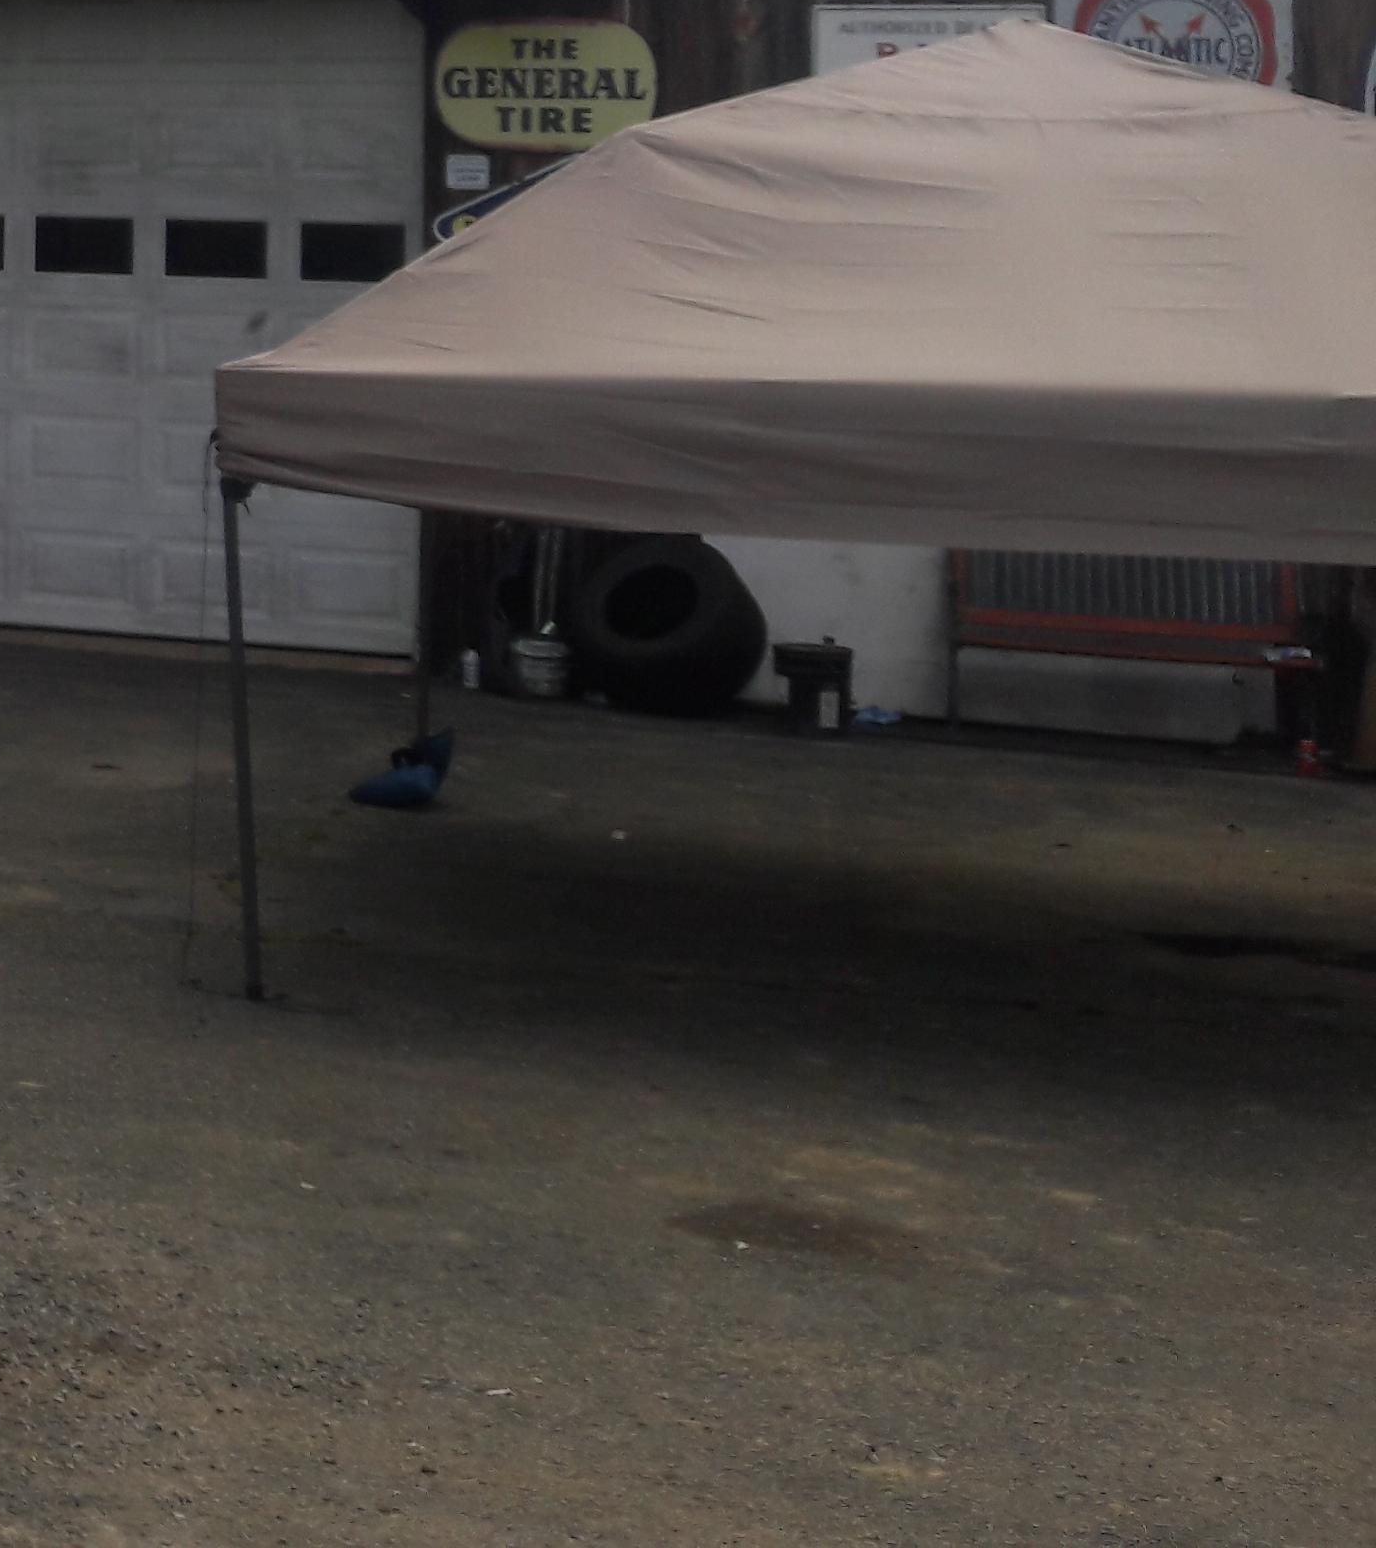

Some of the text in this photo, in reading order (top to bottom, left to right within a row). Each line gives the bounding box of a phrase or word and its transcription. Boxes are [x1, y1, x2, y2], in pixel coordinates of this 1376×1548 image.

[511, 39, 580, 60] THE
[442, 66, 648, 100] GENERAL
[495, 106, 593, 133] TIRE
